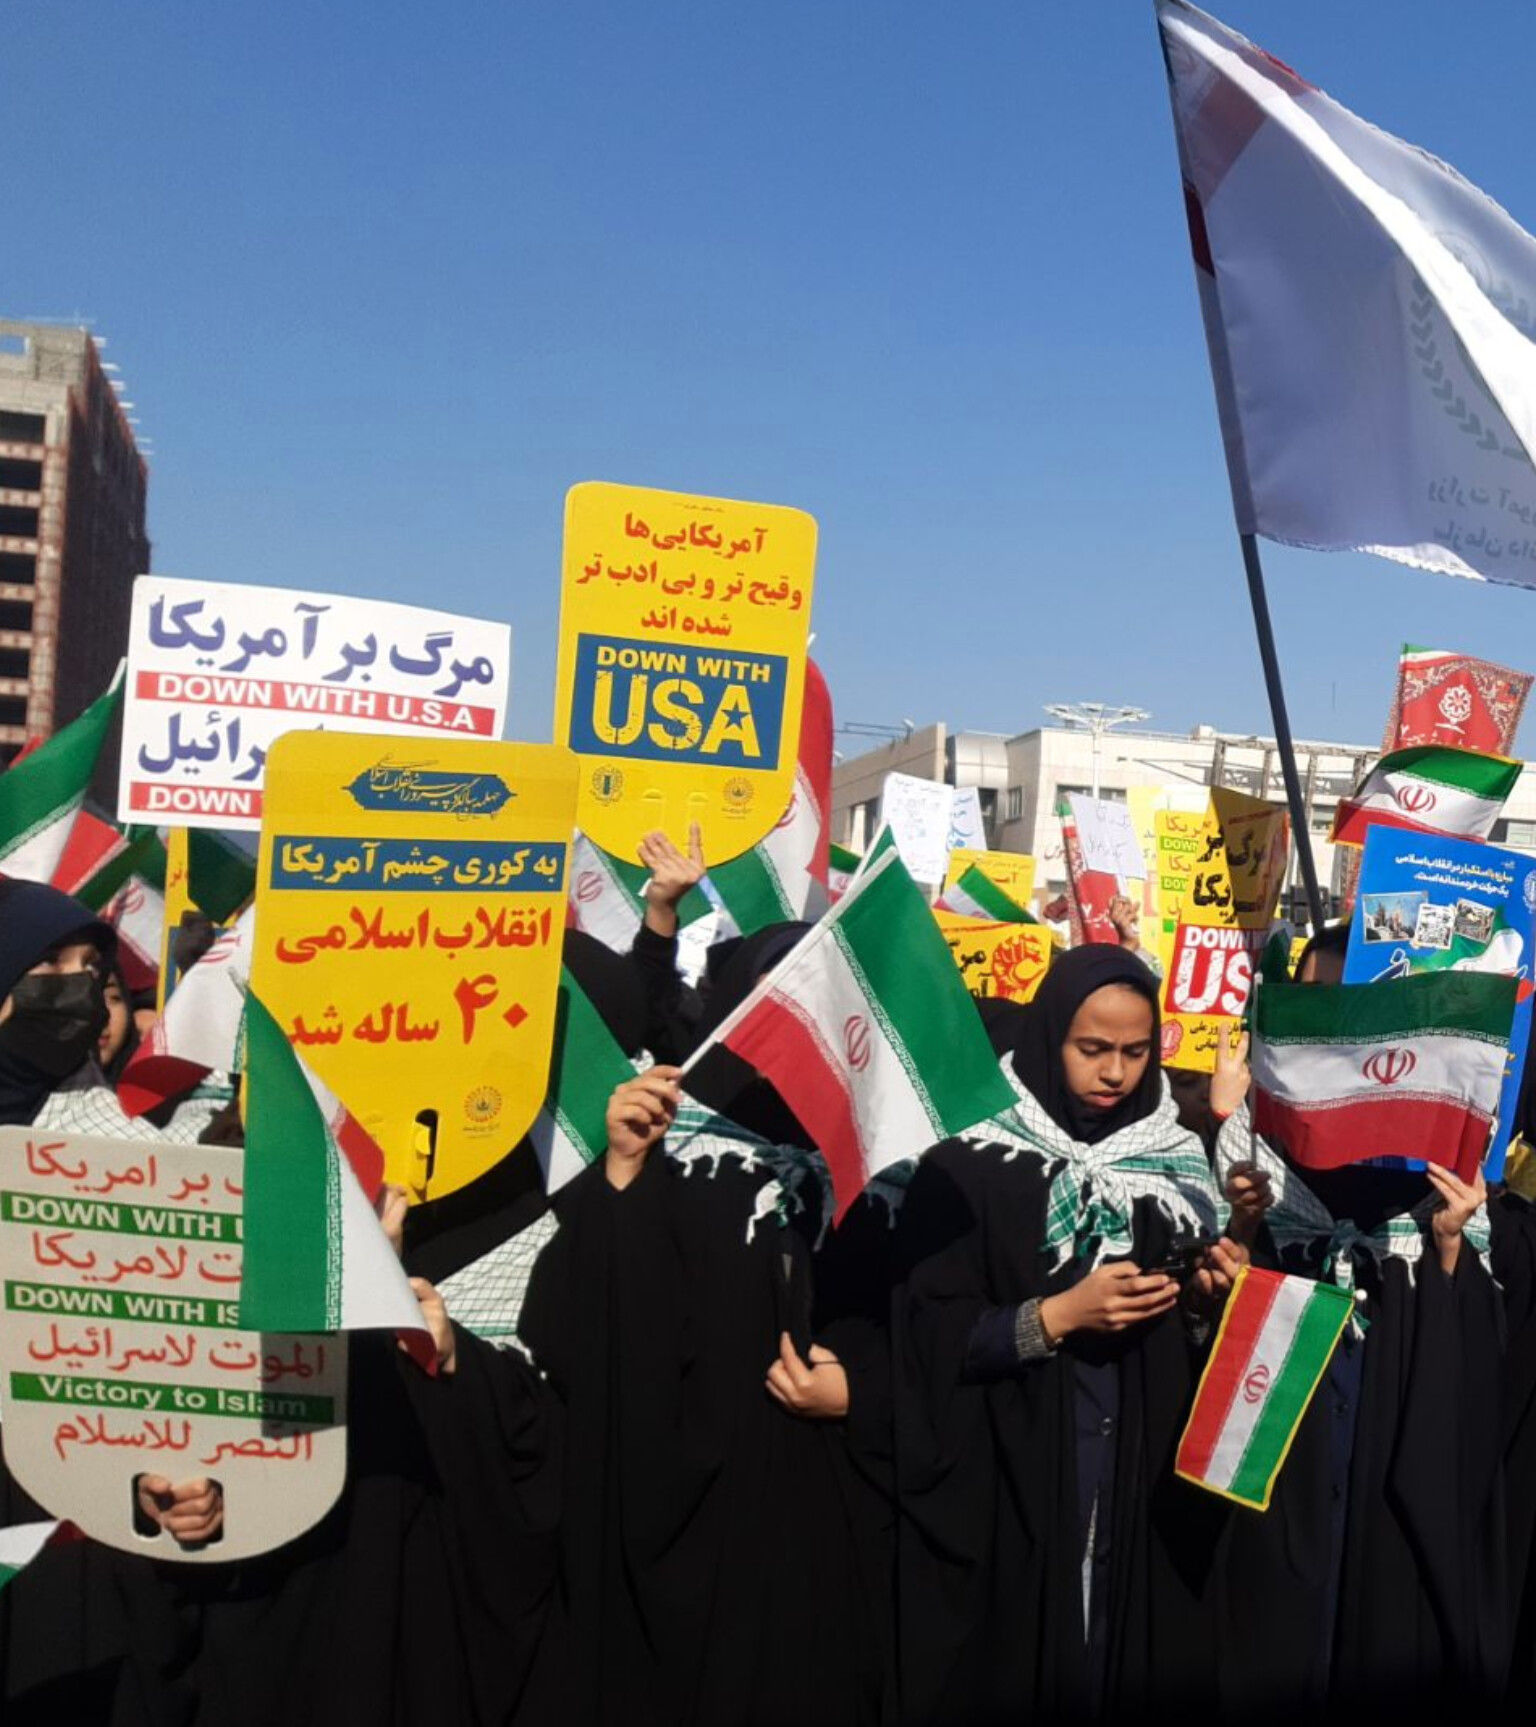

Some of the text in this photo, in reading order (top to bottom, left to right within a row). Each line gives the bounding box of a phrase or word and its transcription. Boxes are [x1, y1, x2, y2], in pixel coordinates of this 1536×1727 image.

[576, 553, 802, 610] وقیح تر و بی ادب تر
[641, 605, 732, 636] شده اند
[150, 594, 494, 697] مرگ بر آمریکا
[597, 646, 770, 683] DOWN WITH
[157, 674, 476, 731] DOWN WITH U.S.A
[592, 670, 761, 758] USA
[147, 787, 251, 815] DOWN
[282, 842, 557, 885] به کوری چشم آمریکا
[276, 905, 552, 964] انقلاب اسلامی
[1173, 947, 1251, 1015] US
[288, 1005, 344, 1046] شد
[353, 1002, 440, 1044] ساله
[26, 1141, 157, 1193] امریکا
[167, 1173, 210, 1205] بر
[11, 1195, 120, 1228] DOWN
[132, 1208, 221, 1239] WITH
[32, 1231, 188, 1284] لامریکا
[13, 1285, 114, 1314] DOWN
[124, 1295, 205, 1324] WITH
[28, 1323, 326, 1383] الموت لاسرائیل
[38, 1376, 308, 1418] Victory to Islam
[54, 1413, 312, 1465] النصر للاسلام
